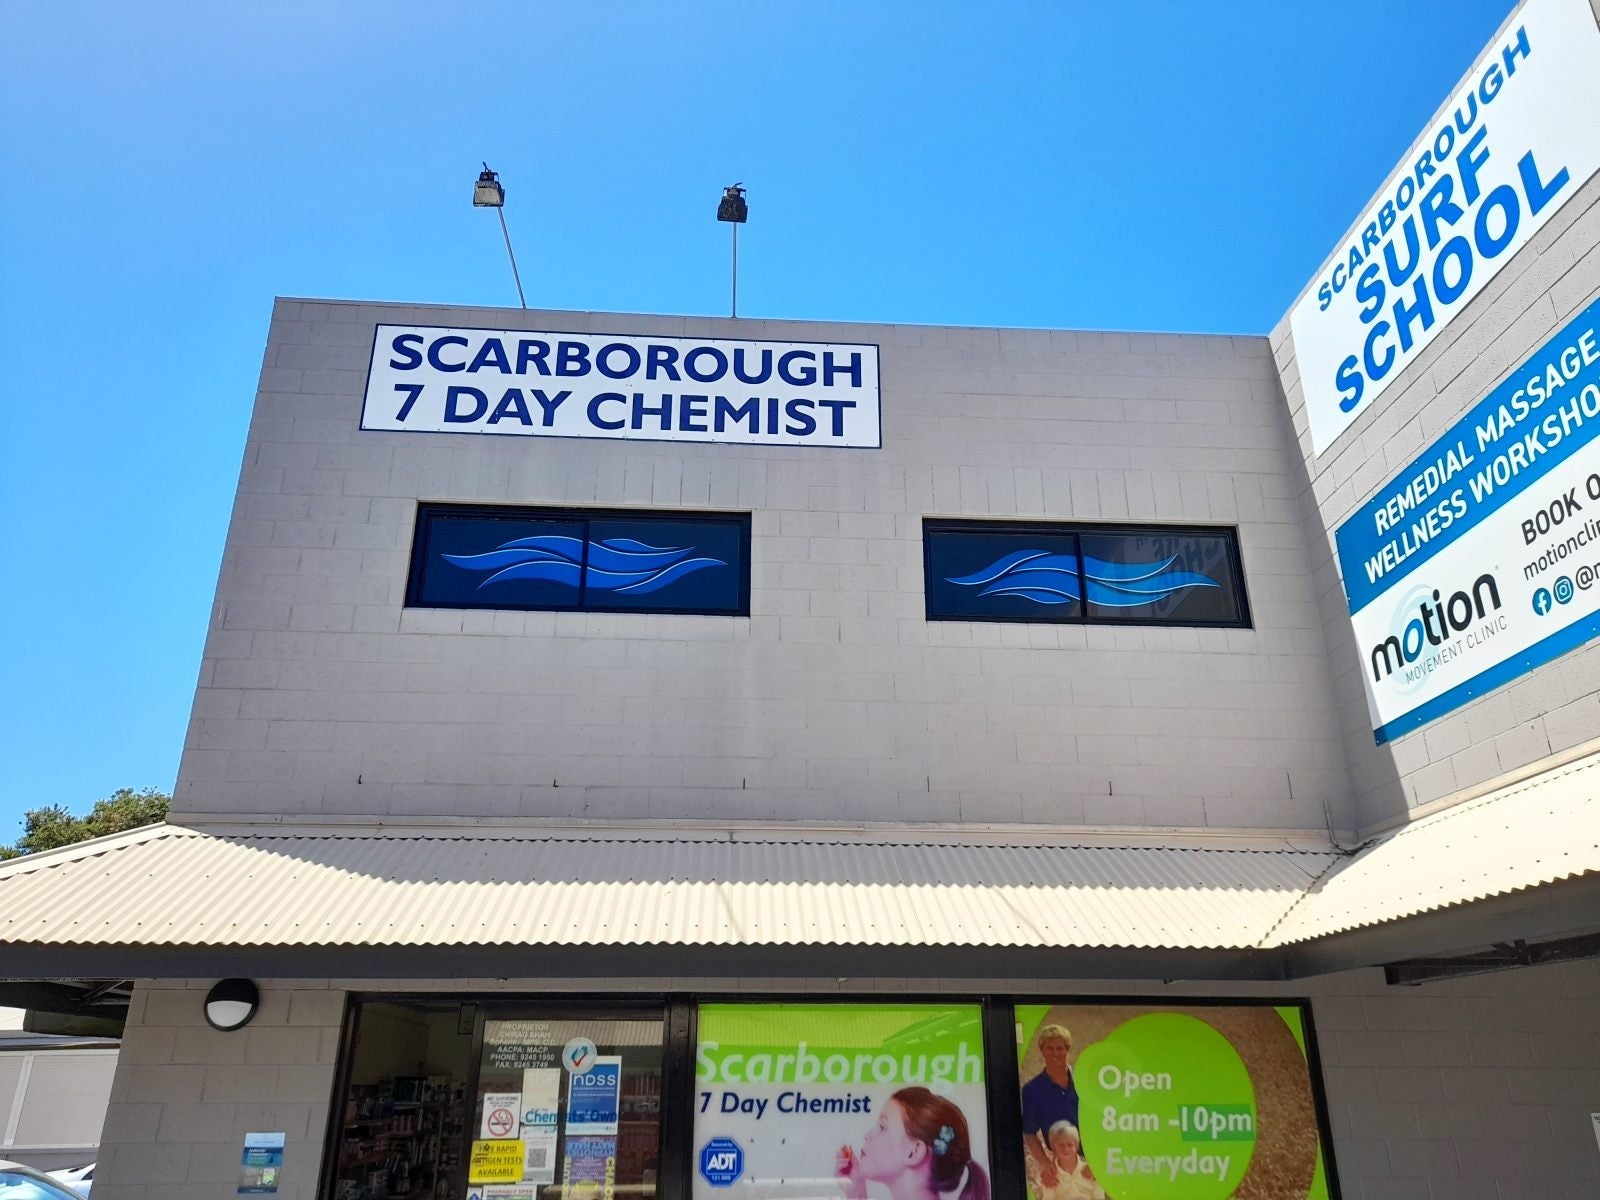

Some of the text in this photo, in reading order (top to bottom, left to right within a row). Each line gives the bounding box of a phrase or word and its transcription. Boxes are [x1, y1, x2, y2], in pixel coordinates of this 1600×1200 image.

[1318, 25, 1531, 312] SCARBOROUGH
[1356, 123, 1490, 324] SURF
[1335, 149, 1570, 413] SCHOOL
[389, 334, 862, 388] SCARBOROUGH
[393, 384, 857, 437] 7 DAY CHEMIST
[1374, 328, 1600, 536] REMEDIAL MASSAGE
[1364, 488, 1468, 584] WELLNESS
[1521, 487, 1583, 545] BOOK
[1371, 574, 1501, 682] motion
[1406, 615, 1507, 685] MOVEMENT CLINIC
[495, 1061, 511, 1069] FAX:
[695, 1041, 981, 1096] Scarborough
[1098, 1065, 1172, 1097] Open
[700, 1092, 871, 1119] 7 Day Chemist
[1102, 1107, 1159, 1131] 8am
[478, 1168, 513, 1176] AVAILABLE
[707, 1153, 736, 1170] ADT
[1106, 1148, 1230, 1181] Everyday
